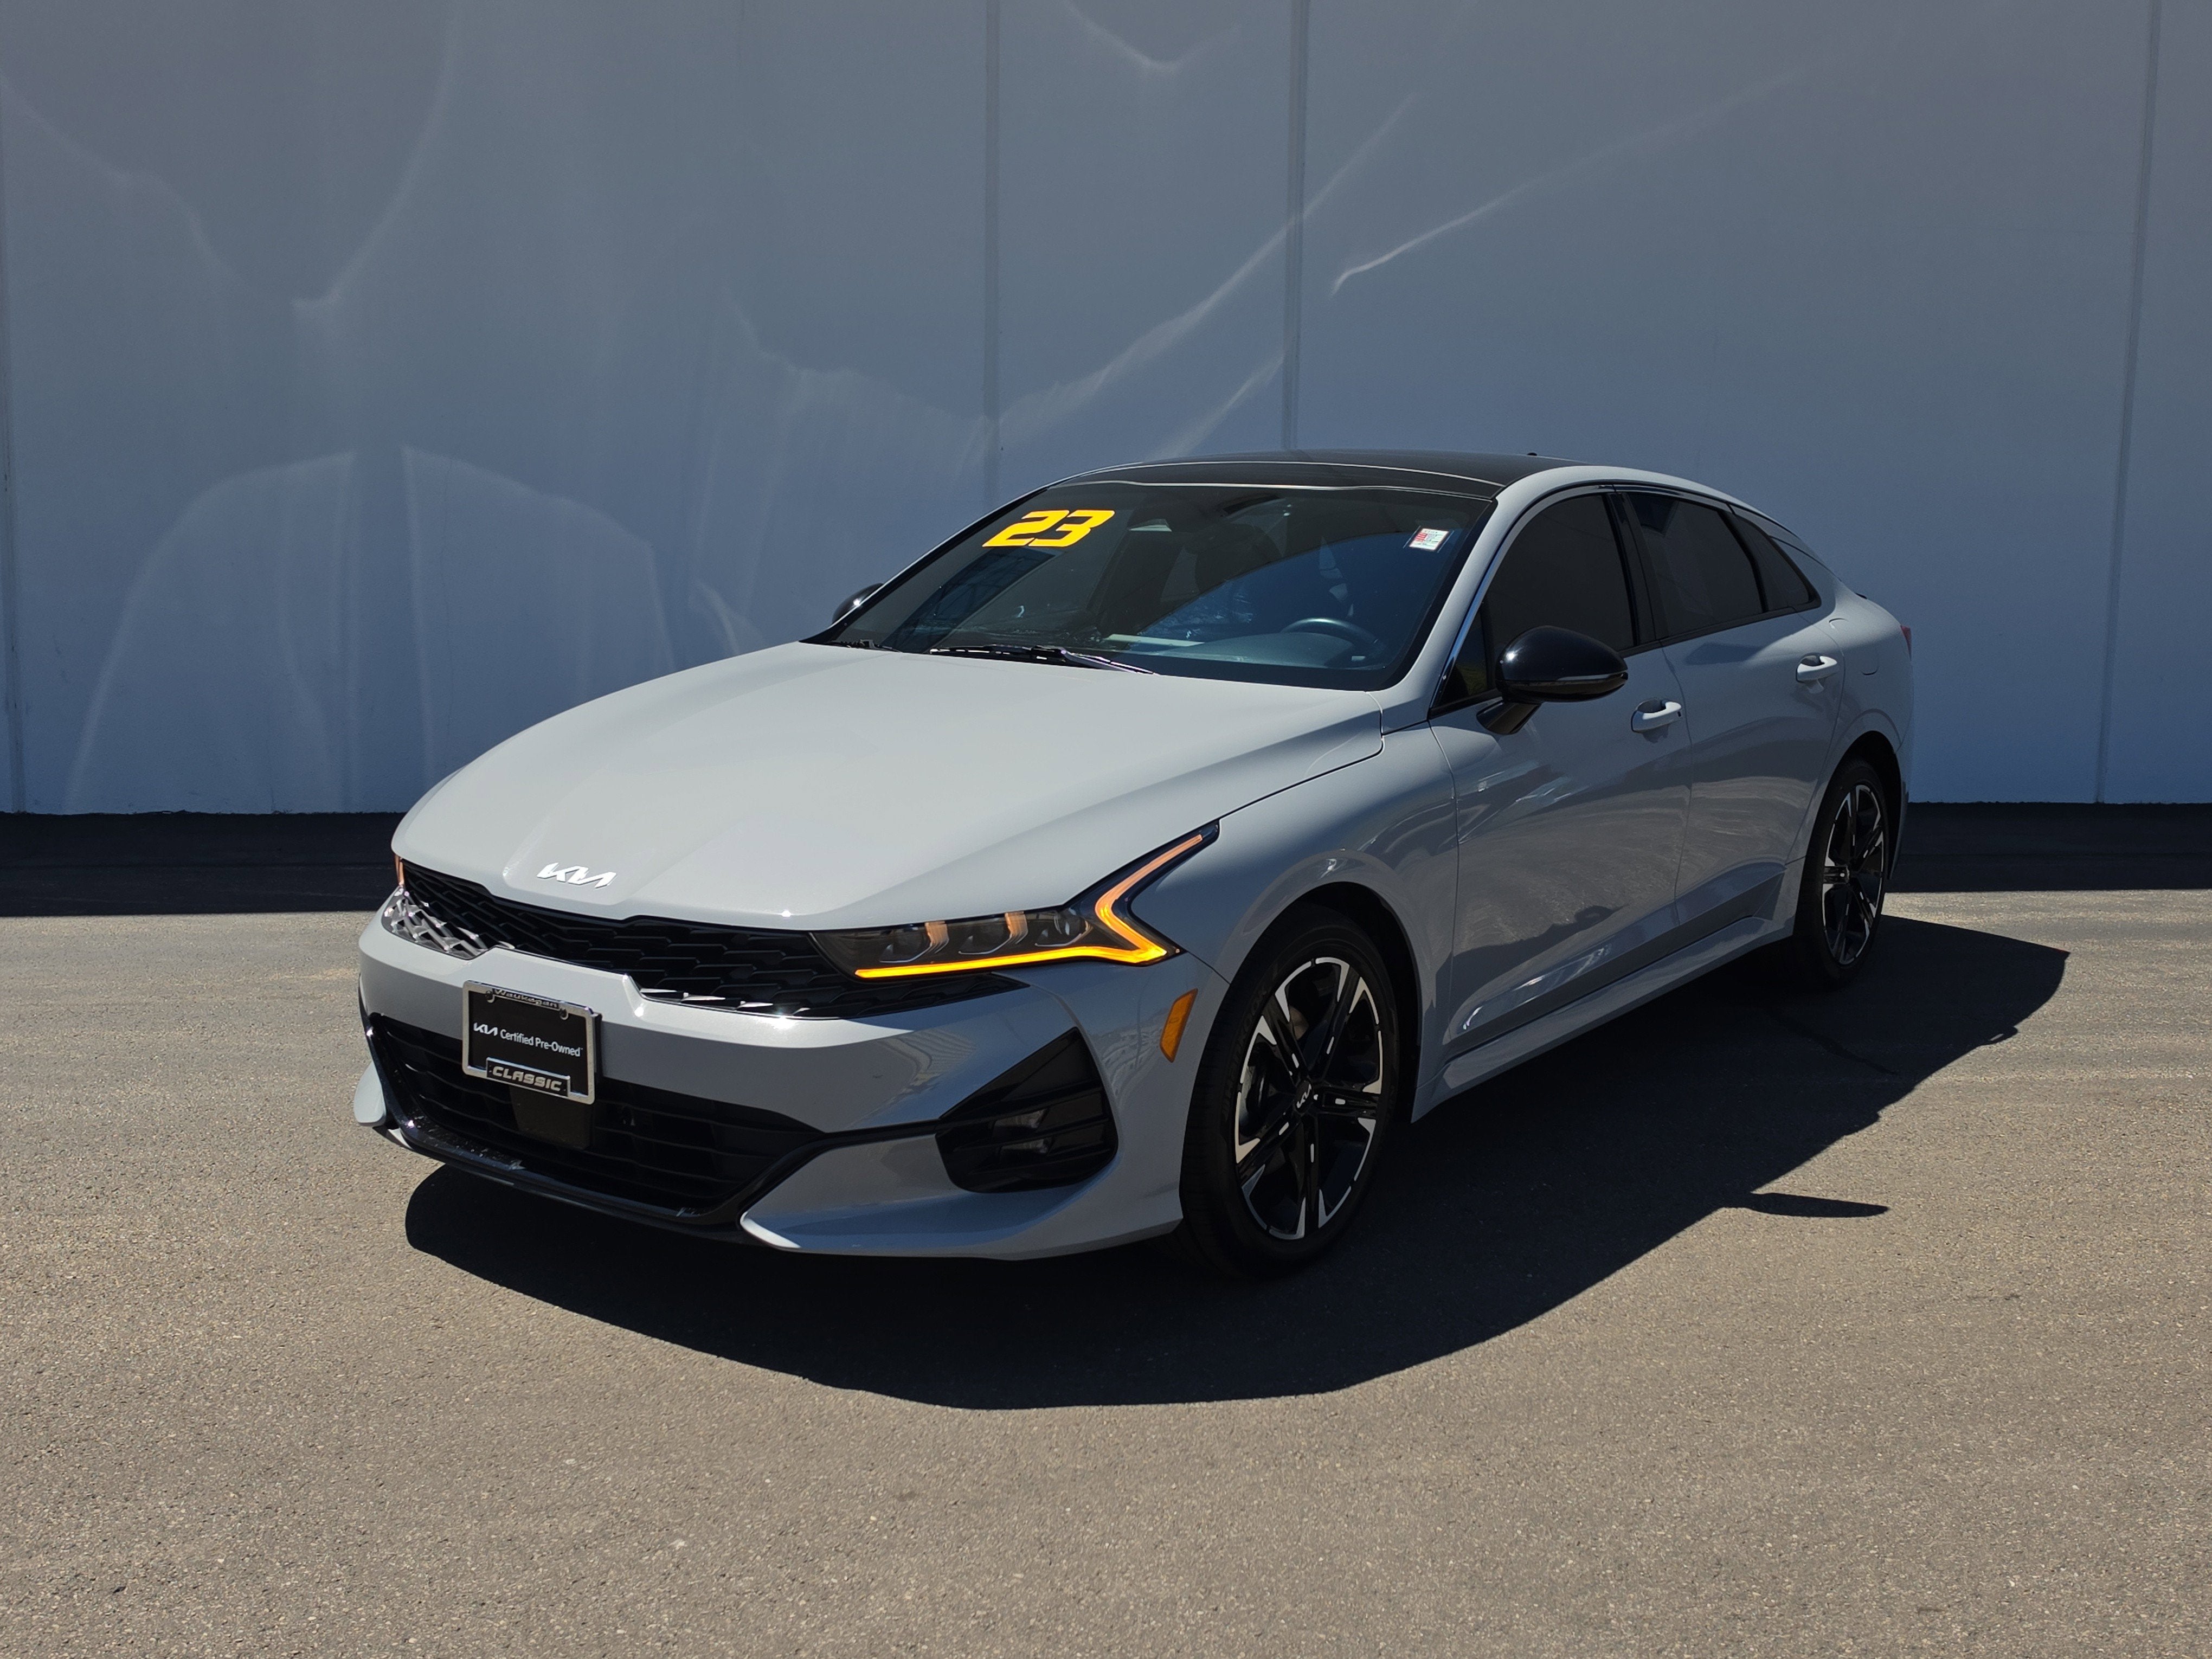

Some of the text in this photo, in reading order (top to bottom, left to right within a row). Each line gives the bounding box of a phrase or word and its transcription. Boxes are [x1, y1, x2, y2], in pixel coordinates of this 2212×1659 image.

[982, 510, 1115, 547] 23
[537, 862, 617, 889] KIA
[473, 1022, 498, 1036] KIA
[500, 1029, 535, 1046] Certified
[492, 1066, 562, 1092] CLASSIC
